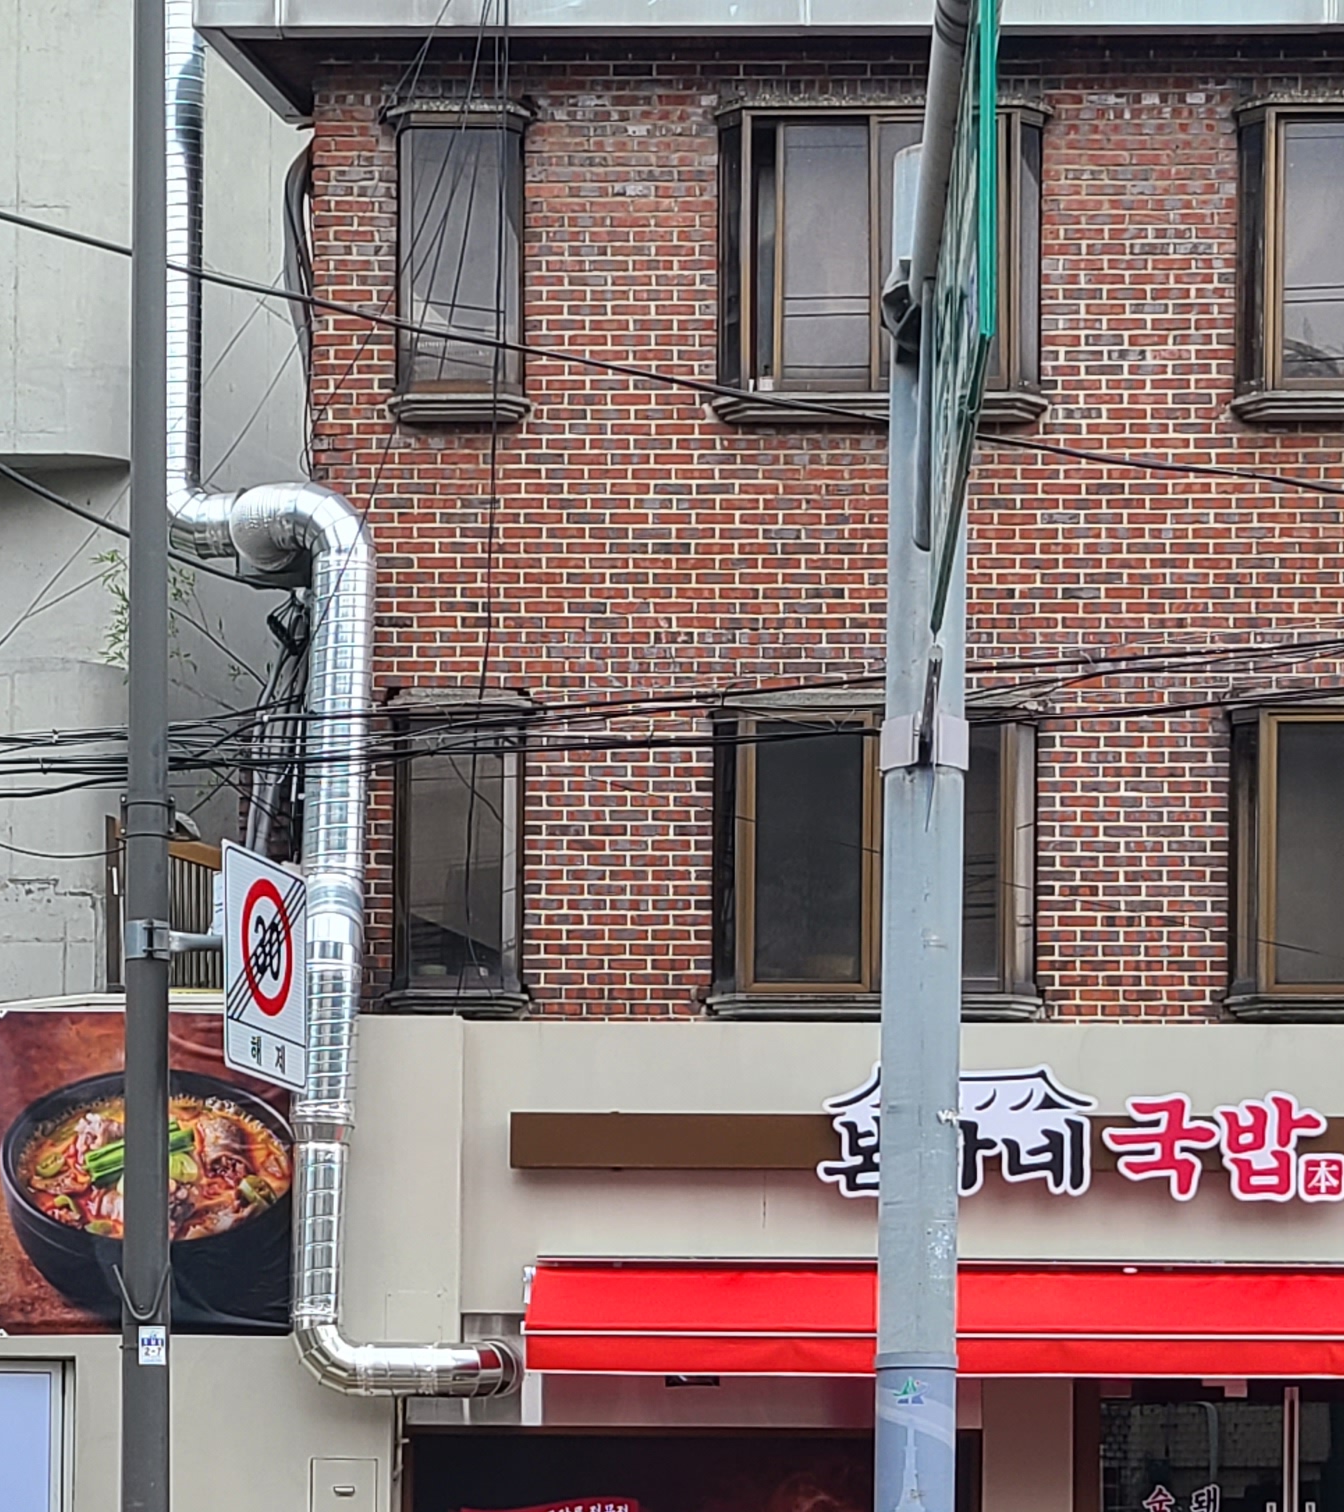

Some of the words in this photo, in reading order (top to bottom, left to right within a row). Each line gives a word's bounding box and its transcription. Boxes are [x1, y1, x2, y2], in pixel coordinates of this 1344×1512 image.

[249, 1034, 286, 1076] 해제
[1105, 1094, 1324, 1198] 국밥
[1306, 1159, 1343, 1196] 本
